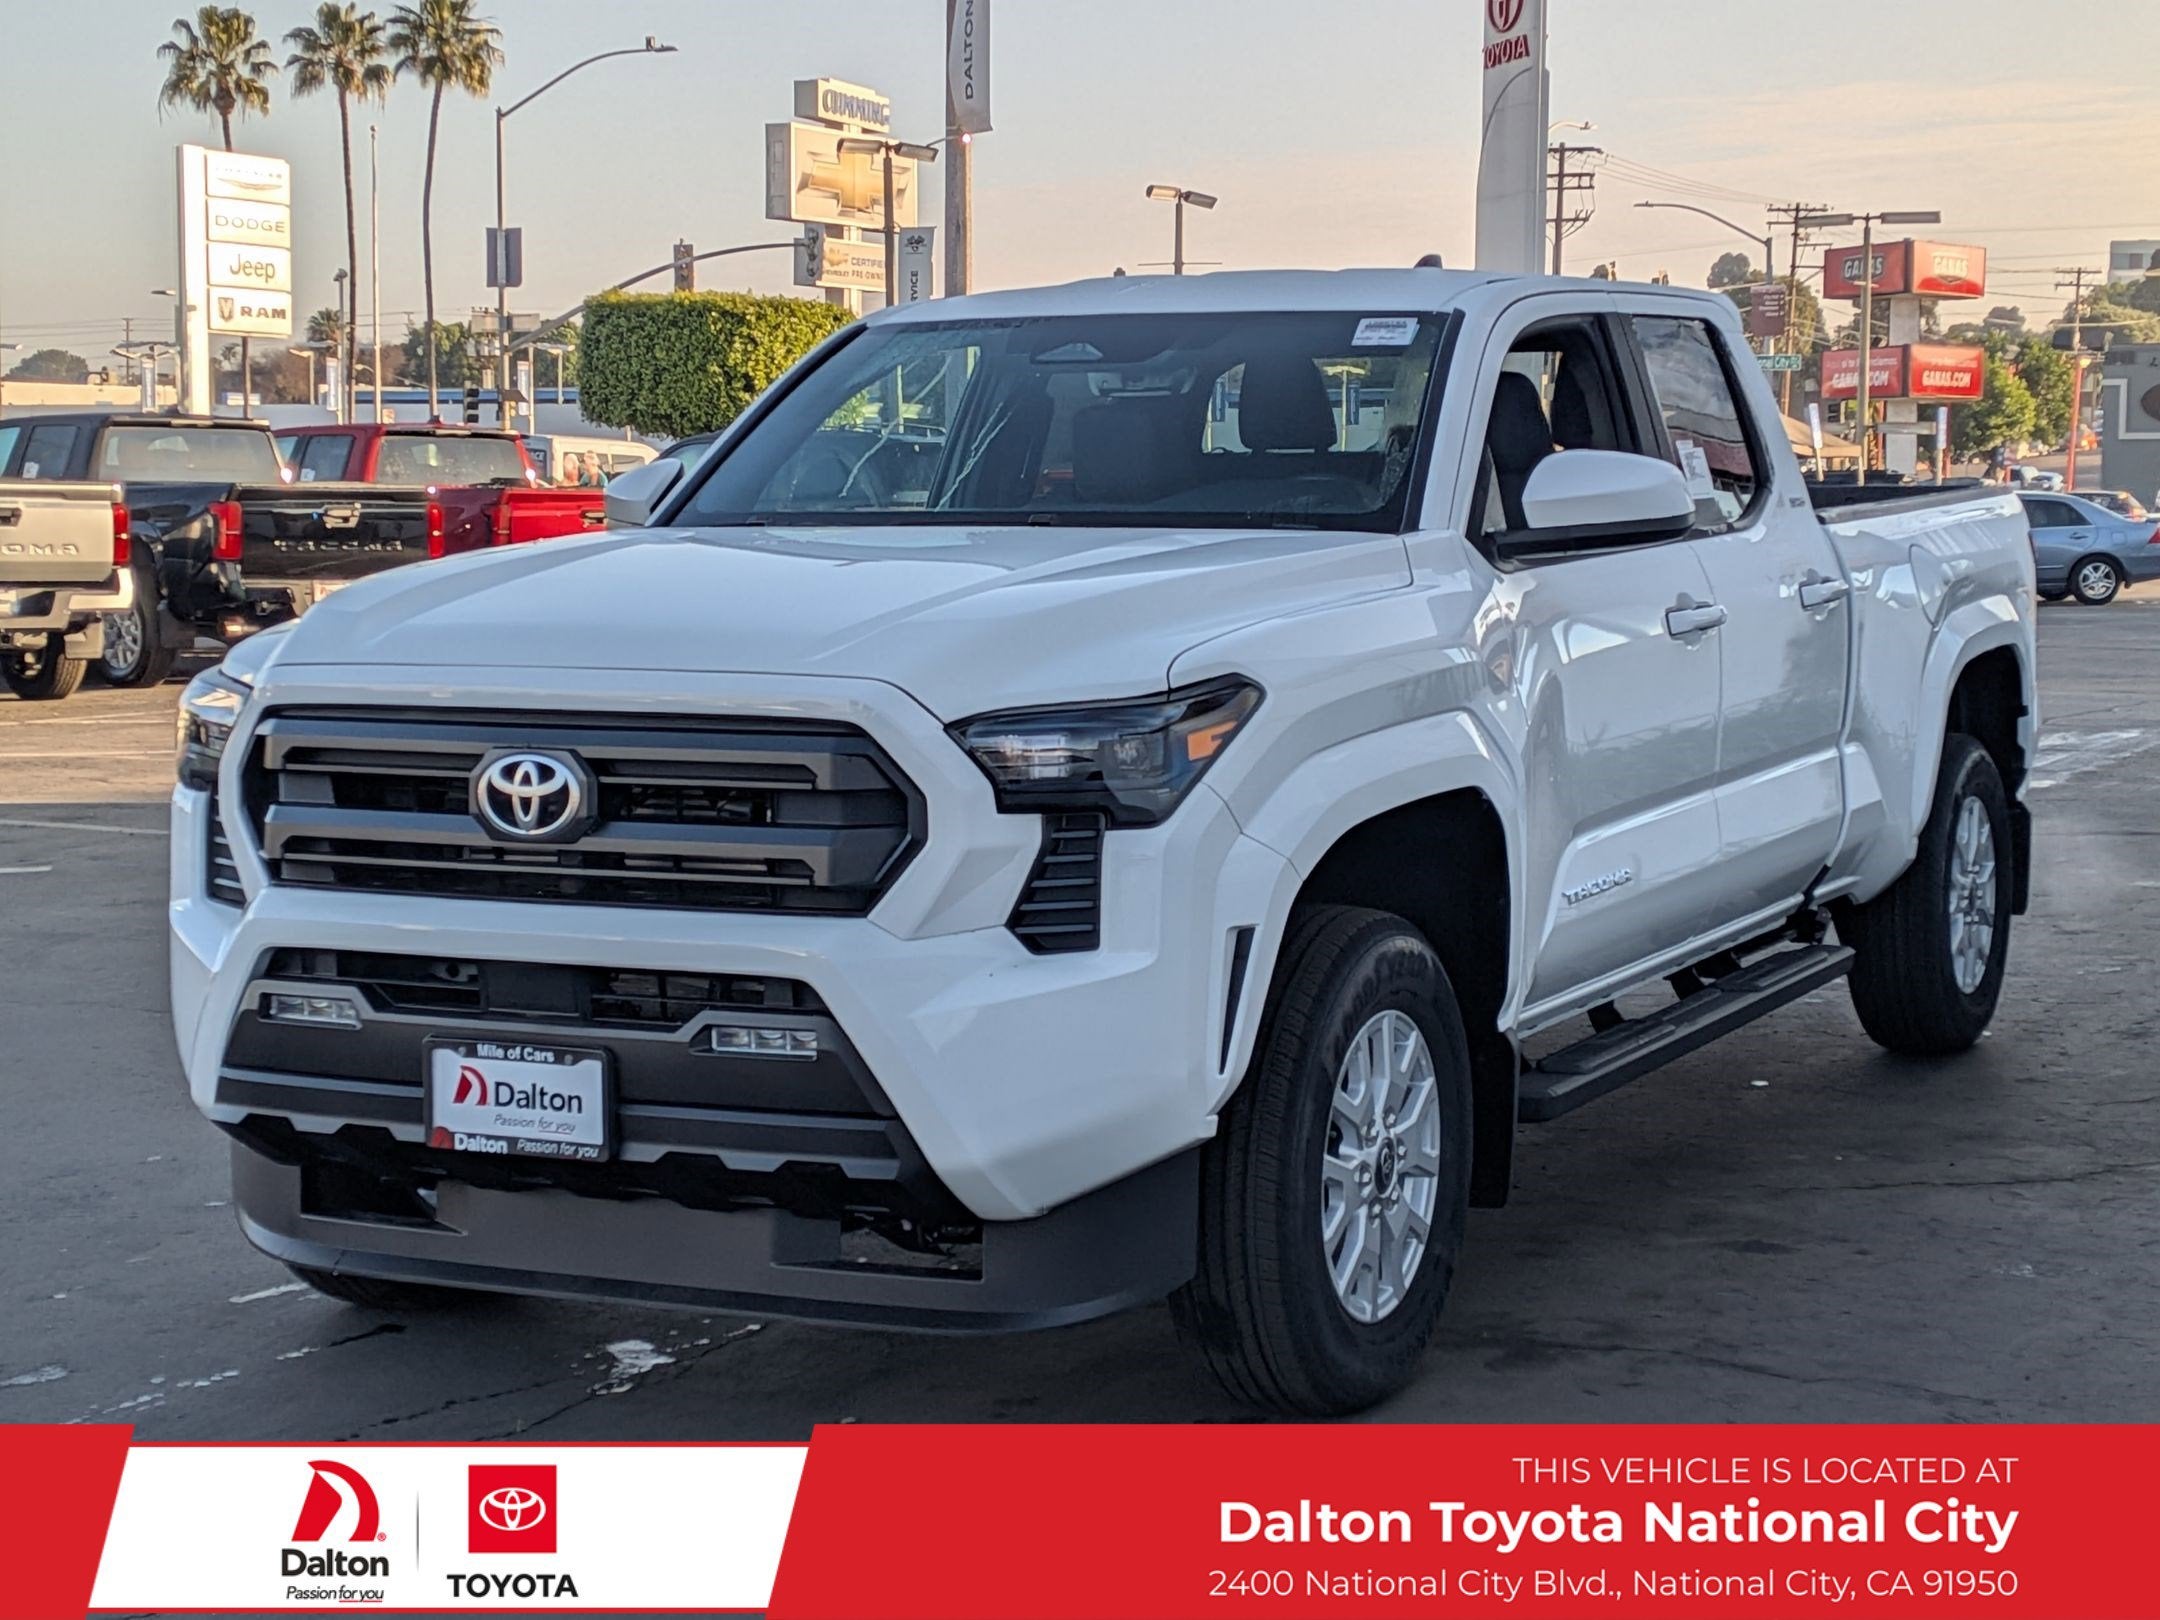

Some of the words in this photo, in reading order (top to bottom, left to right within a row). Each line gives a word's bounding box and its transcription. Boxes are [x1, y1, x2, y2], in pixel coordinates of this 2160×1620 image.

[964, 0, 974, 100] DALTON
[1482, 34, 1530, 69] TOYOTA
[215, 215, 285, 233] DODGE
[230, 253, 276, 283] Jeep
[851, 257, 884, 269] CERTIFIE
[910, 270, 919, 301] RVICE
[240, 305, 287, 319] RAM
[476, 1043, 505, 1059] Mile
[506, 1046, 521, 1060] of
[523, 1047, 555, 1063] Cars
[494, 1081, 583, 1115] Dalton
[494, 1113, 536, 1129] Passion
[537, 1116, 554, 1130] for
[556, 1121, 576, 1134] you
[454, 1133, 509, 1155] Dalton
[516, 1138, 559, 1155] Passion
[560, 1142, 577, 1155] for
[576, 1145, 600, 1160] you
